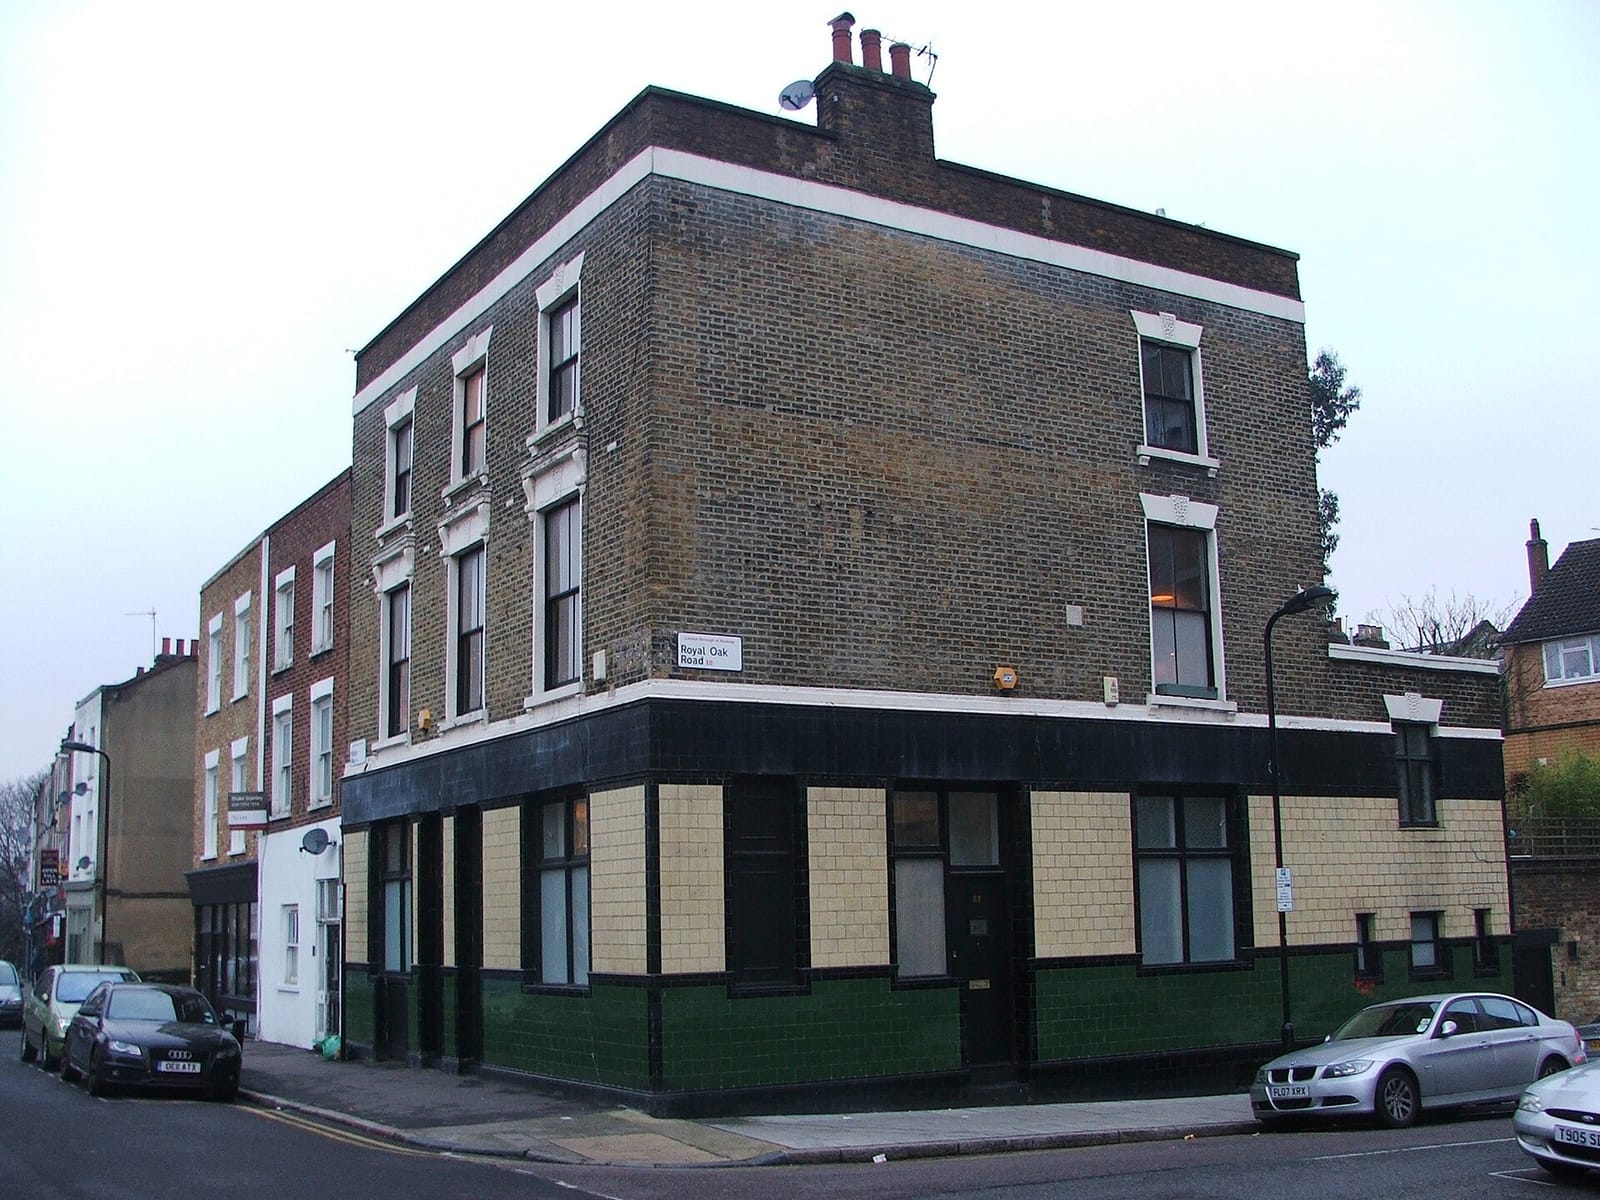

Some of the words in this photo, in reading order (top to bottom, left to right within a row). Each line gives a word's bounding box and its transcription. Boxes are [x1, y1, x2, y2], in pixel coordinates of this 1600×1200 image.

[681, 644, 706, 656] Royal
[710, 646, 728, 657] Oak
[681, 655, 704, 665] Road
[1273, 1087, 1290, 1097] FL07
[1559, 1127, 1587, 1144] T905
